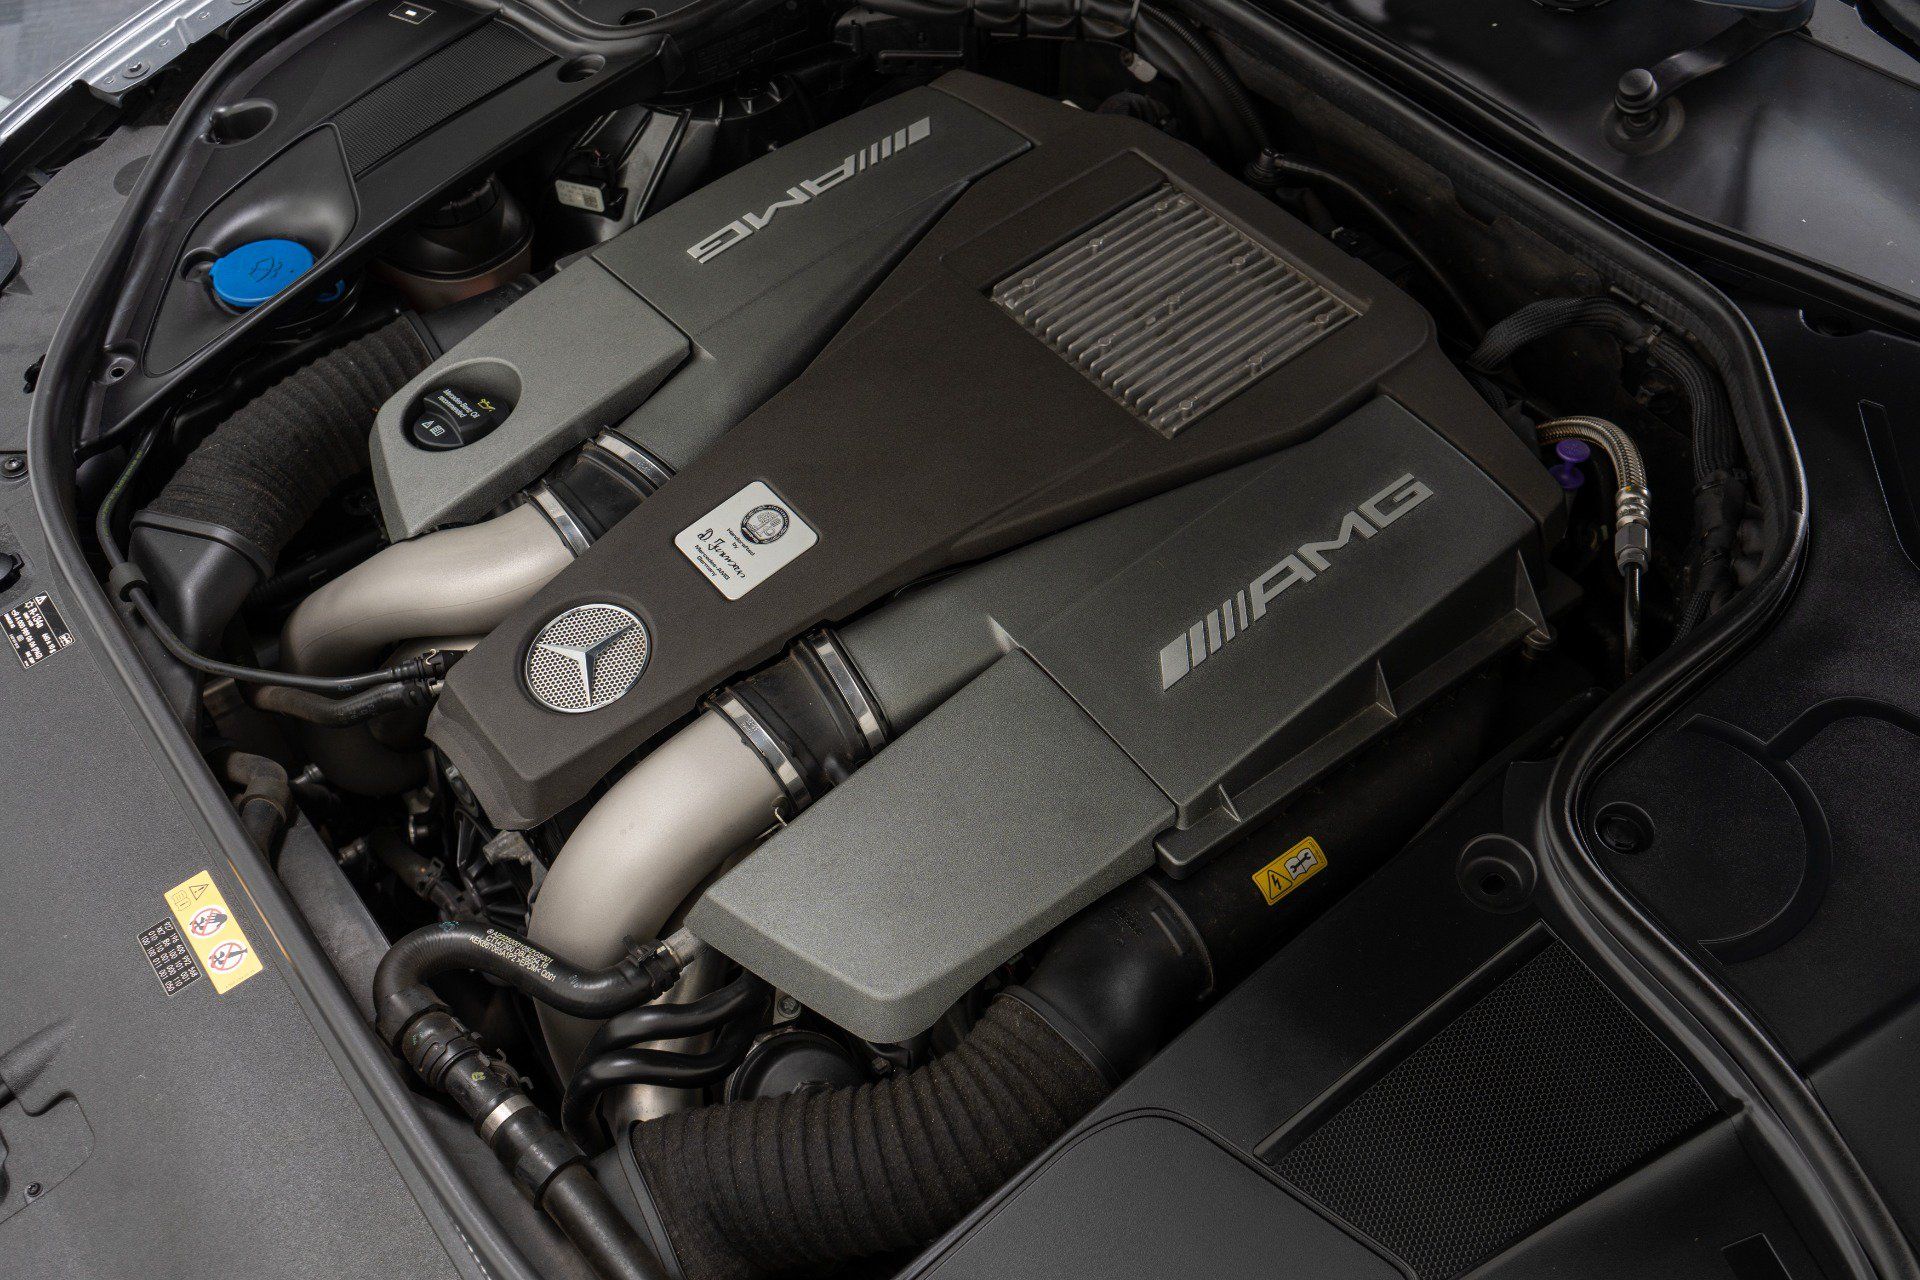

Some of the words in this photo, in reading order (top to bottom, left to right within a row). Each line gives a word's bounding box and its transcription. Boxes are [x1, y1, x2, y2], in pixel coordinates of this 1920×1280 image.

[686, 154, 856, 264] AMG
[727, 528, 755, 556] Handcrafted
[731, 541, 739, 549] by
[1249, 473, 1433, 620] AMG
[694, 545, 730, 580] Mercedes-AMG
[696, 556, 717, 577] Germany
[28, 607, 44, 628] R-134a
[140, 935, 150, 946] 100
[151, 956, 162, 968] 011
[147, 929, 158, 941] 010
[154, 942, 164, 953] 110
[159, 952, 170, 964] 001
[172, 975, 183, 987] 110
[173, 960, 184, 971] 101
